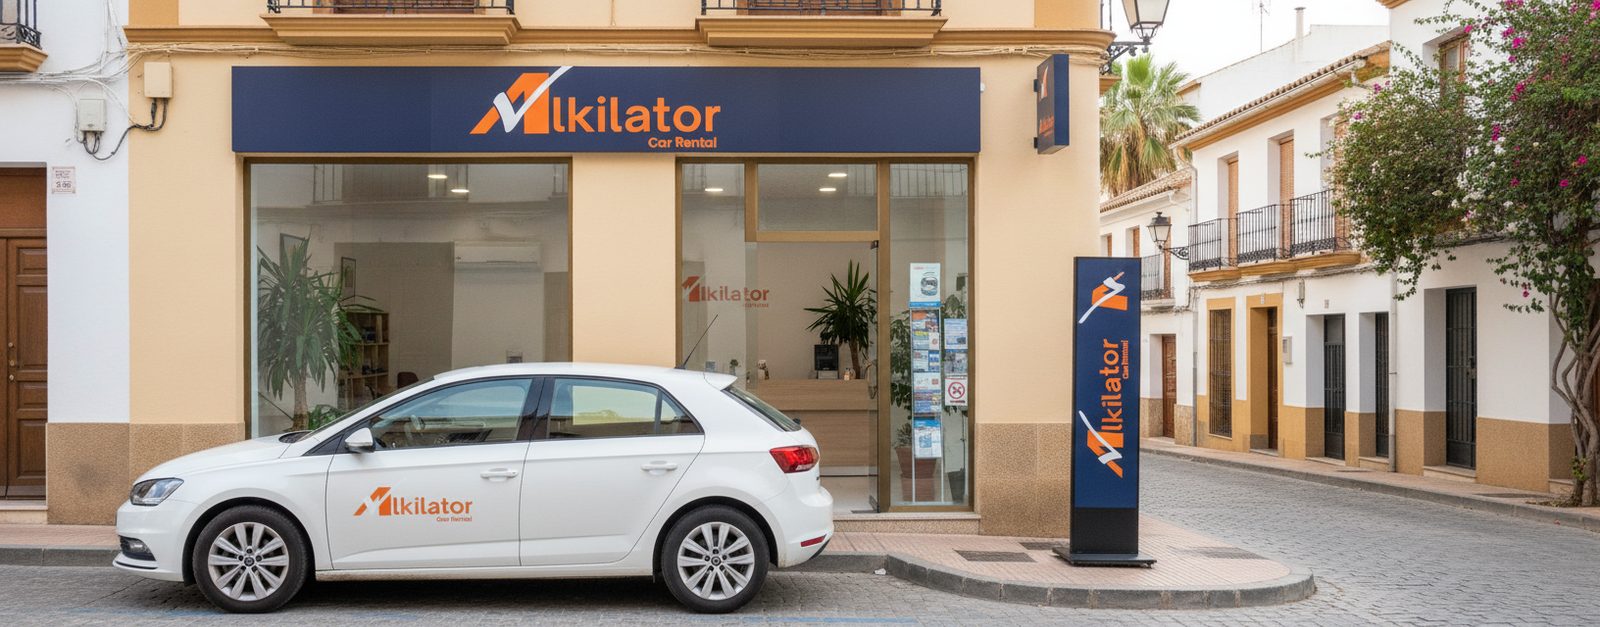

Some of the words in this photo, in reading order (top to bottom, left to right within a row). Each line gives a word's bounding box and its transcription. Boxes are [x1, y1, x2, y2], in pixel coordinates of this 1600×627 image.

[469, 66, 721, 135] Alkilator
[648, 137, 672, 149] Car
[675, 136, 718, 149] Rental
[1087, 339, 1123, 478] Alkilator
[353, 486, 473, 516] Alkilator
